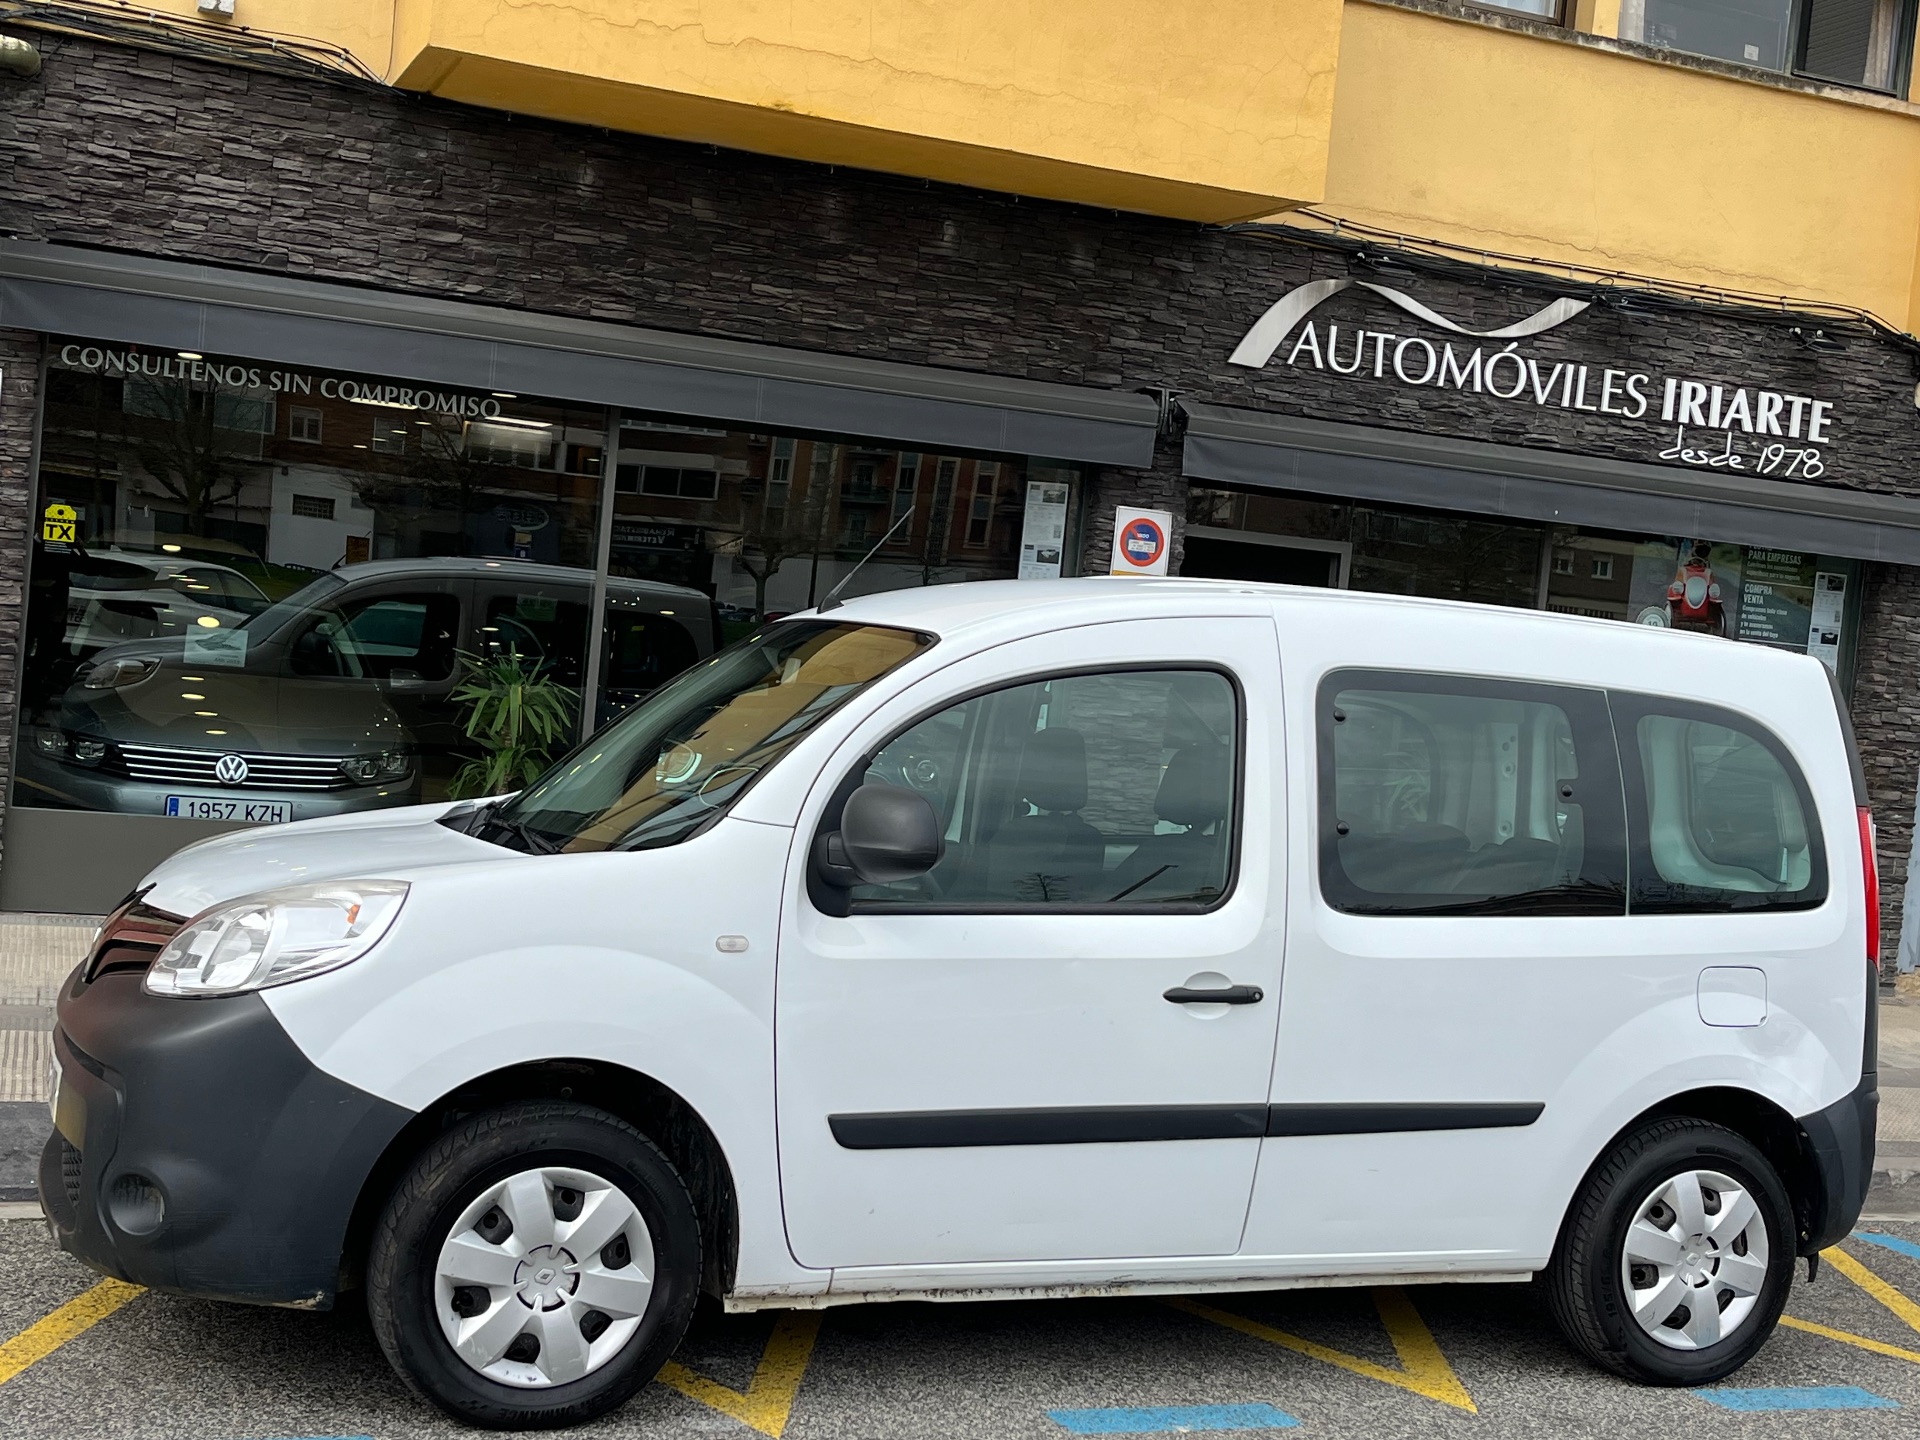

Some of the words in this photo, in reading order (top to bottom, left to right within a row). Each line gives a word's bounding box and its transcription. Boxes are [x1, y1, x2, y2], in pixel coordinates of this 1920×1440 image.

[60, 344, 261, 389] CONSULTENOS
[269, 371, 312, 395] SIN
[320, 378, 501, 419] COMPROMISO
[1287, 320, 1649, 418] AUTOMÓVILES
[1661, 377, 1834, 444] IRIARTE
[1658, 424, 1745, 470] desde
[1755, 443, 1825, 479] 1978
[45, 523, 73, 541] TX
[1748, 549, 1766, 561] PARA
[1767, 551, 1802, 565] EMPRESAS
[1743, 593, 1764, 605] VENTA
[1744, 583, 1773, 596] COMPRA
[188, 802, 237, 820] 1957
[245, 804, 283, 822] KZH
